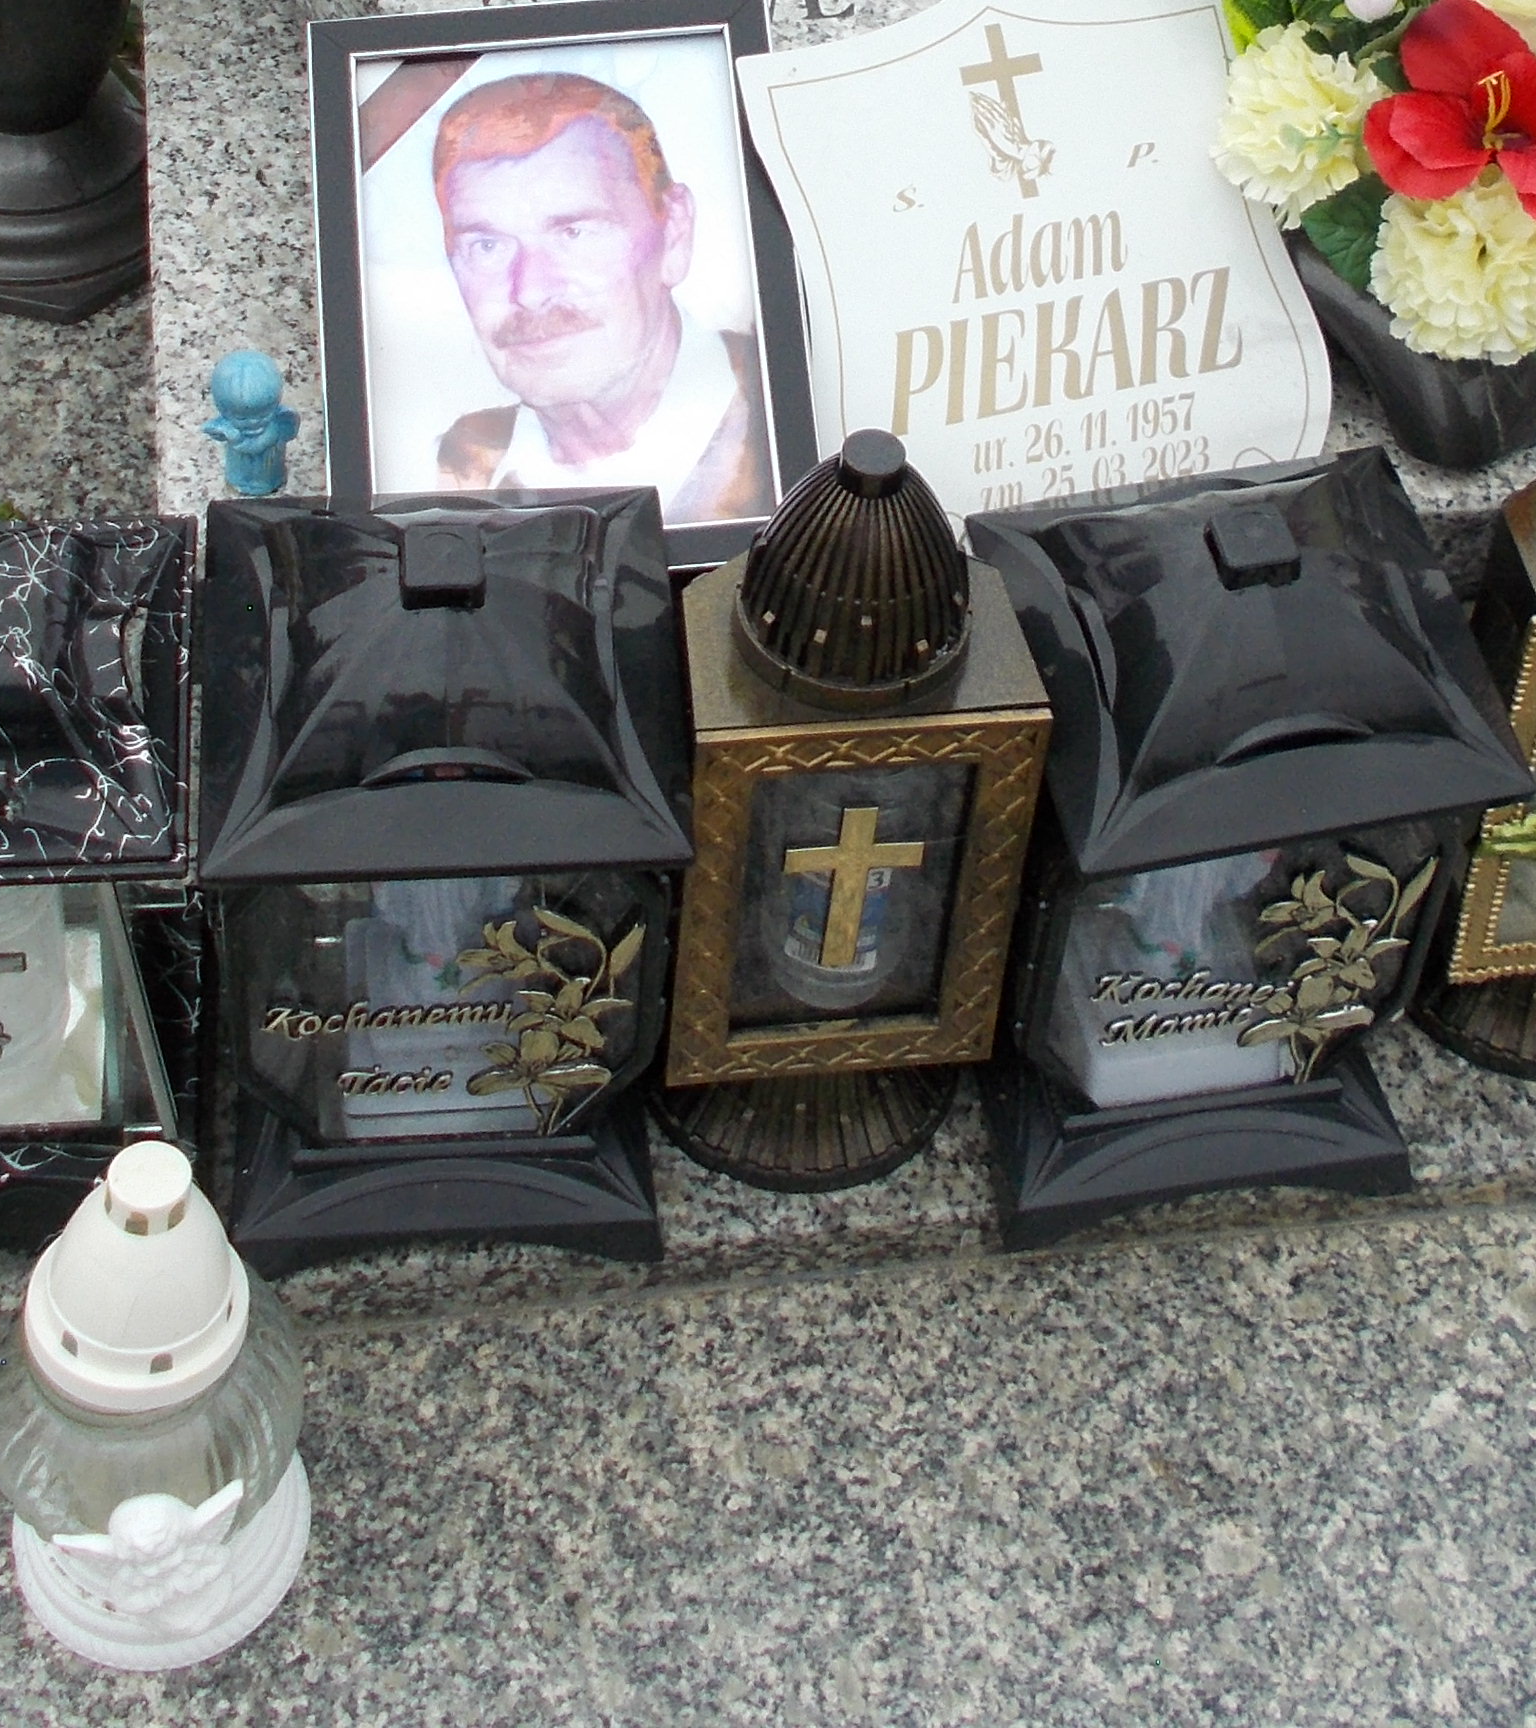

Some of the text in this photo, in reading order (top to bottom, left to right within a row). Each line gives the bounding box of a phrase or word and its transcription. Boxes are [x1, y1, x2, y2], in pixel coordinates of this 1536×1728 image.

[1126, 141, 1159, 168] P.
[952, 209, 1128, 304] Adam
[890, 266, 1244, 437] PIEKARZ
[972, 392, 1196, 475] ur. 26. 11. 1957
[1143, 436, 1210, 483] 2023
[260, 1001, 514, 1041] Kochanemu
[337, 1064, 454, 1097] Tacie
